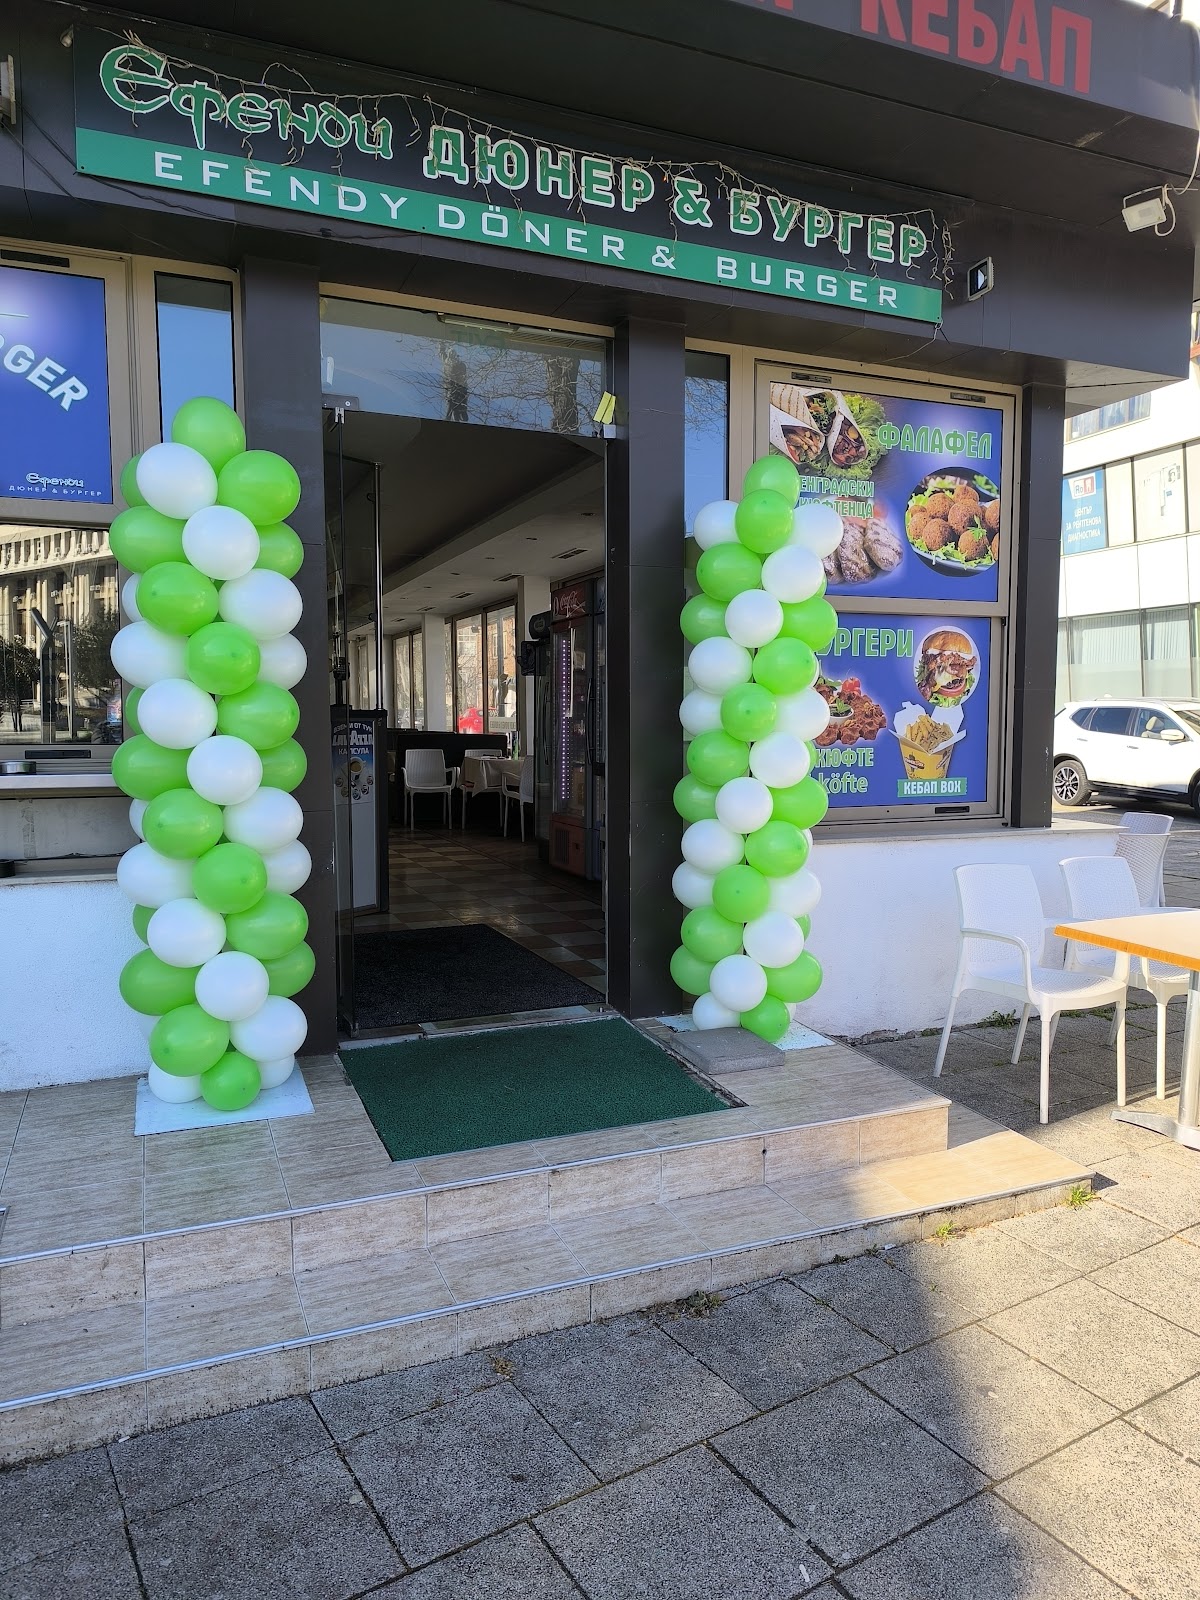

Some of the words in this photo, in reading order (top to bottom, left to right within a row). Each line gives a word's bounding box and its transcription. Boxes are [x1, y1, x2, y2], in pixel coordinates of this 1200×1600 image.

[99, 44, 394, 160] Ефенди
[423, 124, 655, 213] ДЮНЕР
[674, 176, 713, 228] &
[729, 187, 929, 267] БУРГЕР
[154, 151, 407, 220] EFENDY
[438, 205, 627, 261] DÖNER
[651, 246, 677, 270] &
[716, 256, 898, 309] BURGER
[0, 333, 89, 411] GER
[877, 422, 992, 459] ФАЛАФЕЛ
[9, 485, 47, 493] ДЮНЕР
[800, 475, 874, 497] ЕНГРАДСКИ
[1074, 506, 1093, 517] ЦЕНТЪР
[1065, 522, 1072, 531] ЗА
[815, 748, 874, 767] КЮФТЕ
[818, 771, 868, 793] köfte
[904, 781, 937, 795] КЕБАП
